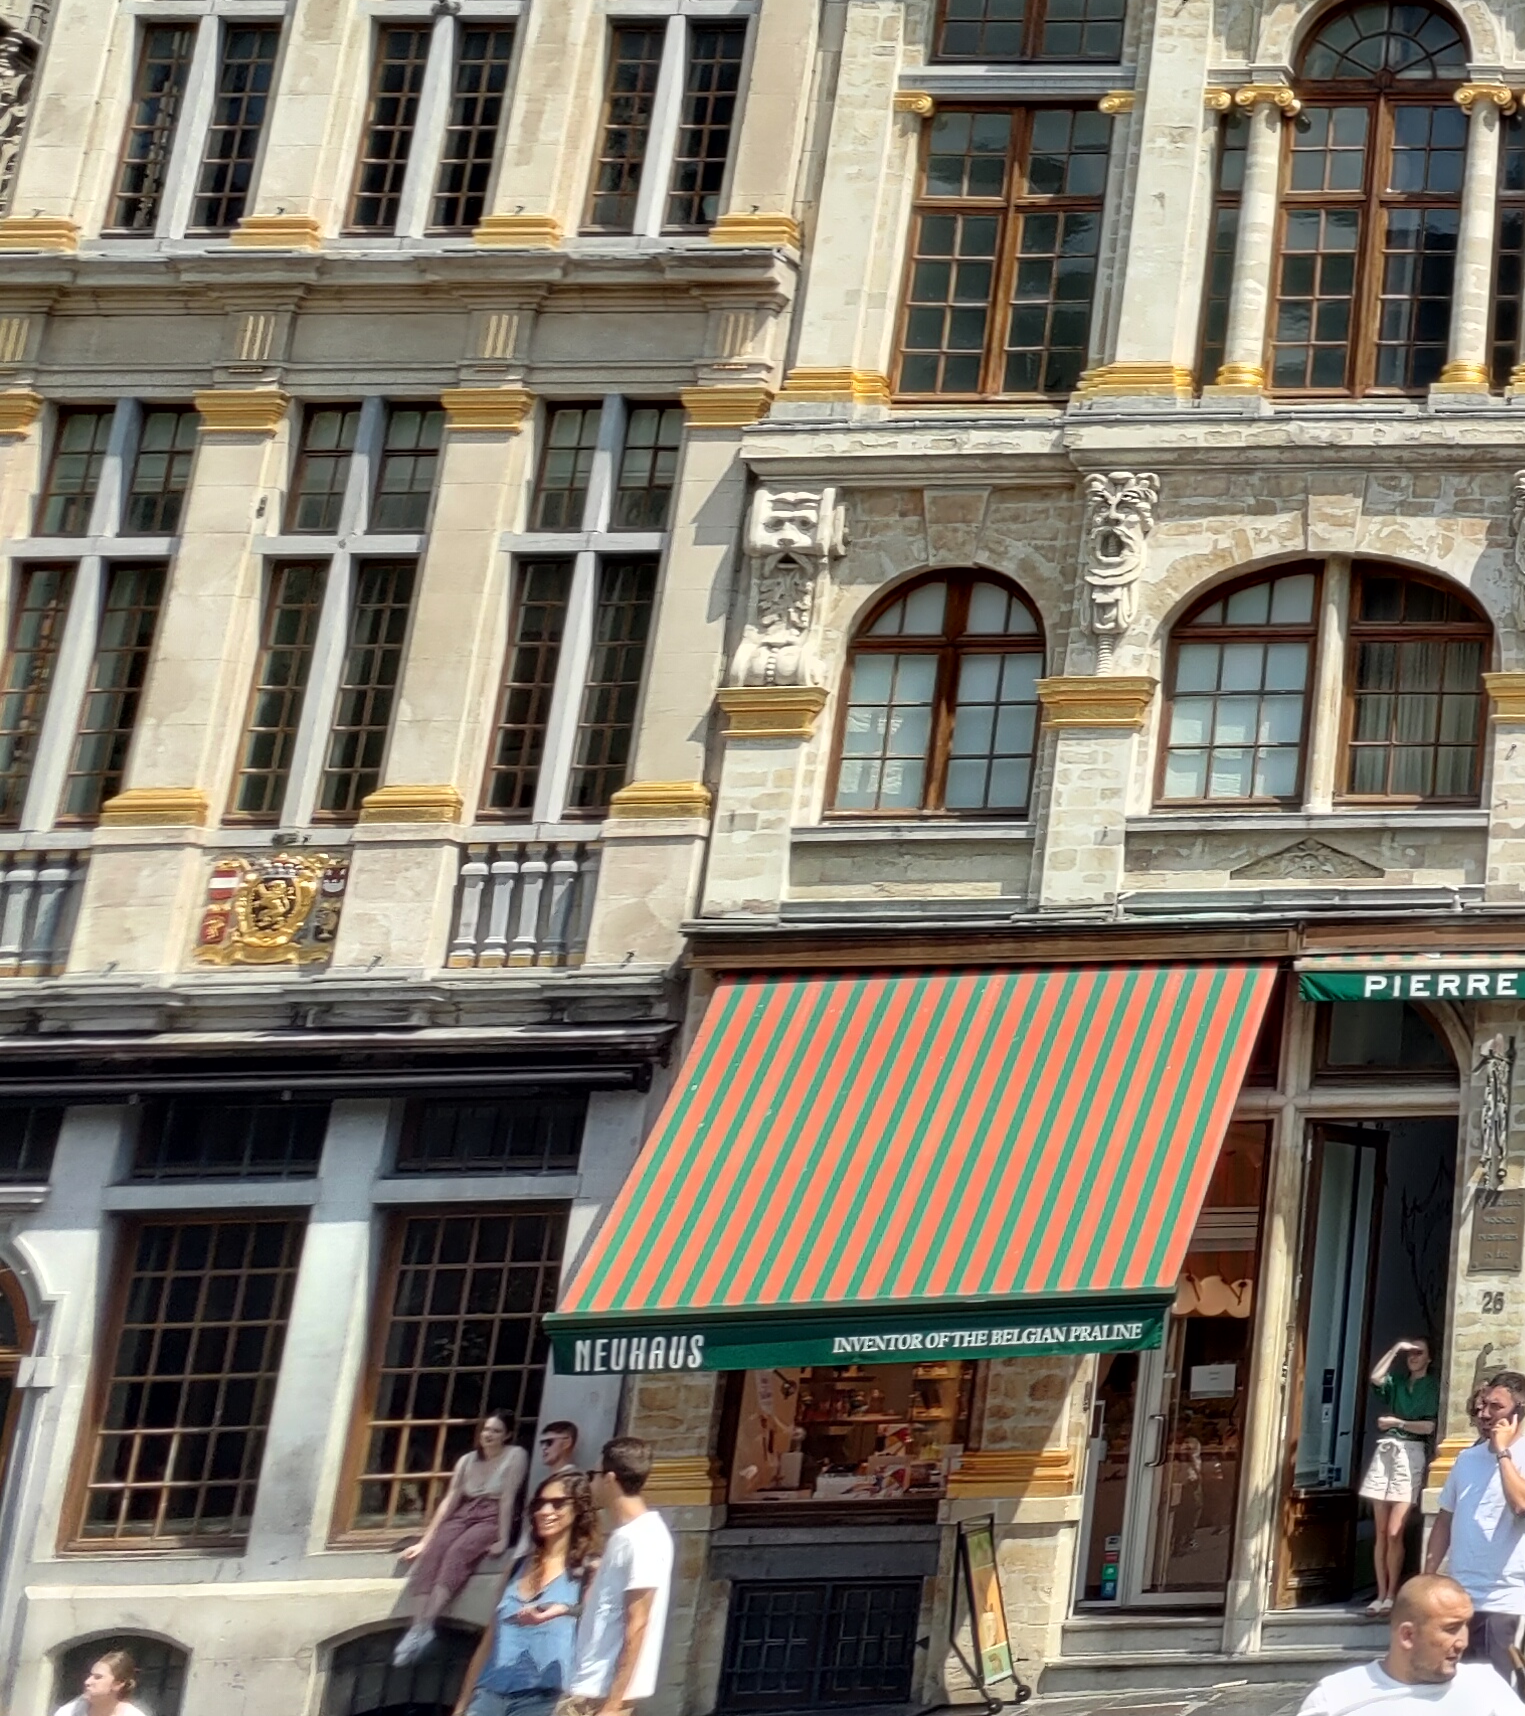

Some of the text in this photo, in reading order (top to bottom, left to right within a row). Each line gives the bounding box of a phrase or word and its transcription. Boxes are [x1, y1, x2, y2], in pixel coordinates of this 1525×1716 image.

[1363, 973, 1518, 998] PIERRE
[1482, 1291, 1504, 1315] 26
[833, 1324, 1142, 1353] INVENTOR OF THE BELGIAN PRALINE
[574, 1335, 704, 1372] NEUHAUS
